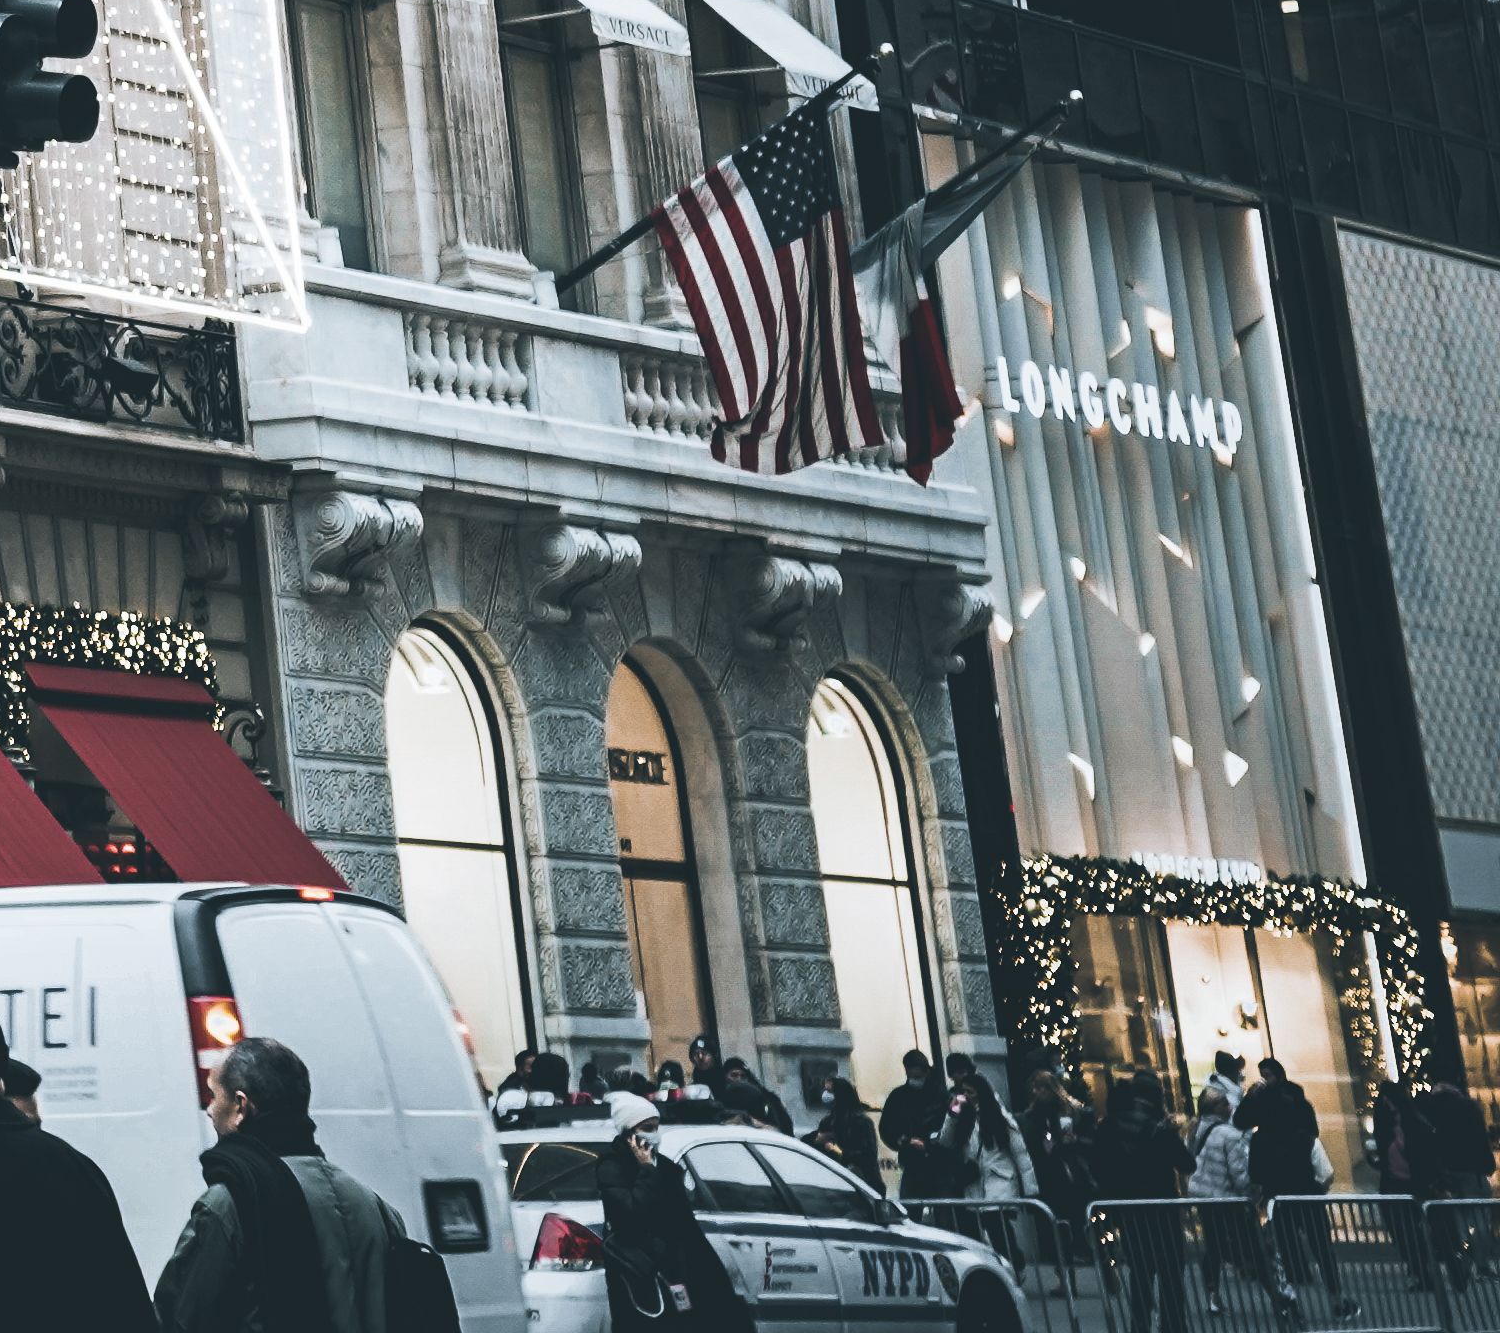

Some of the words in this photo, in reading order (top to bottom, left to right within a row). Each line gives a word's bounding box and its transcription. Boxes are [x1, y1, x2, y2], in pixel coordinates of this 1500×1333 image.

[608, 19, 672, 46] VERSACE
[996, 355, 1243, 454] LONGCHAMP
[859, 1249, 931, 1297] NYPD
